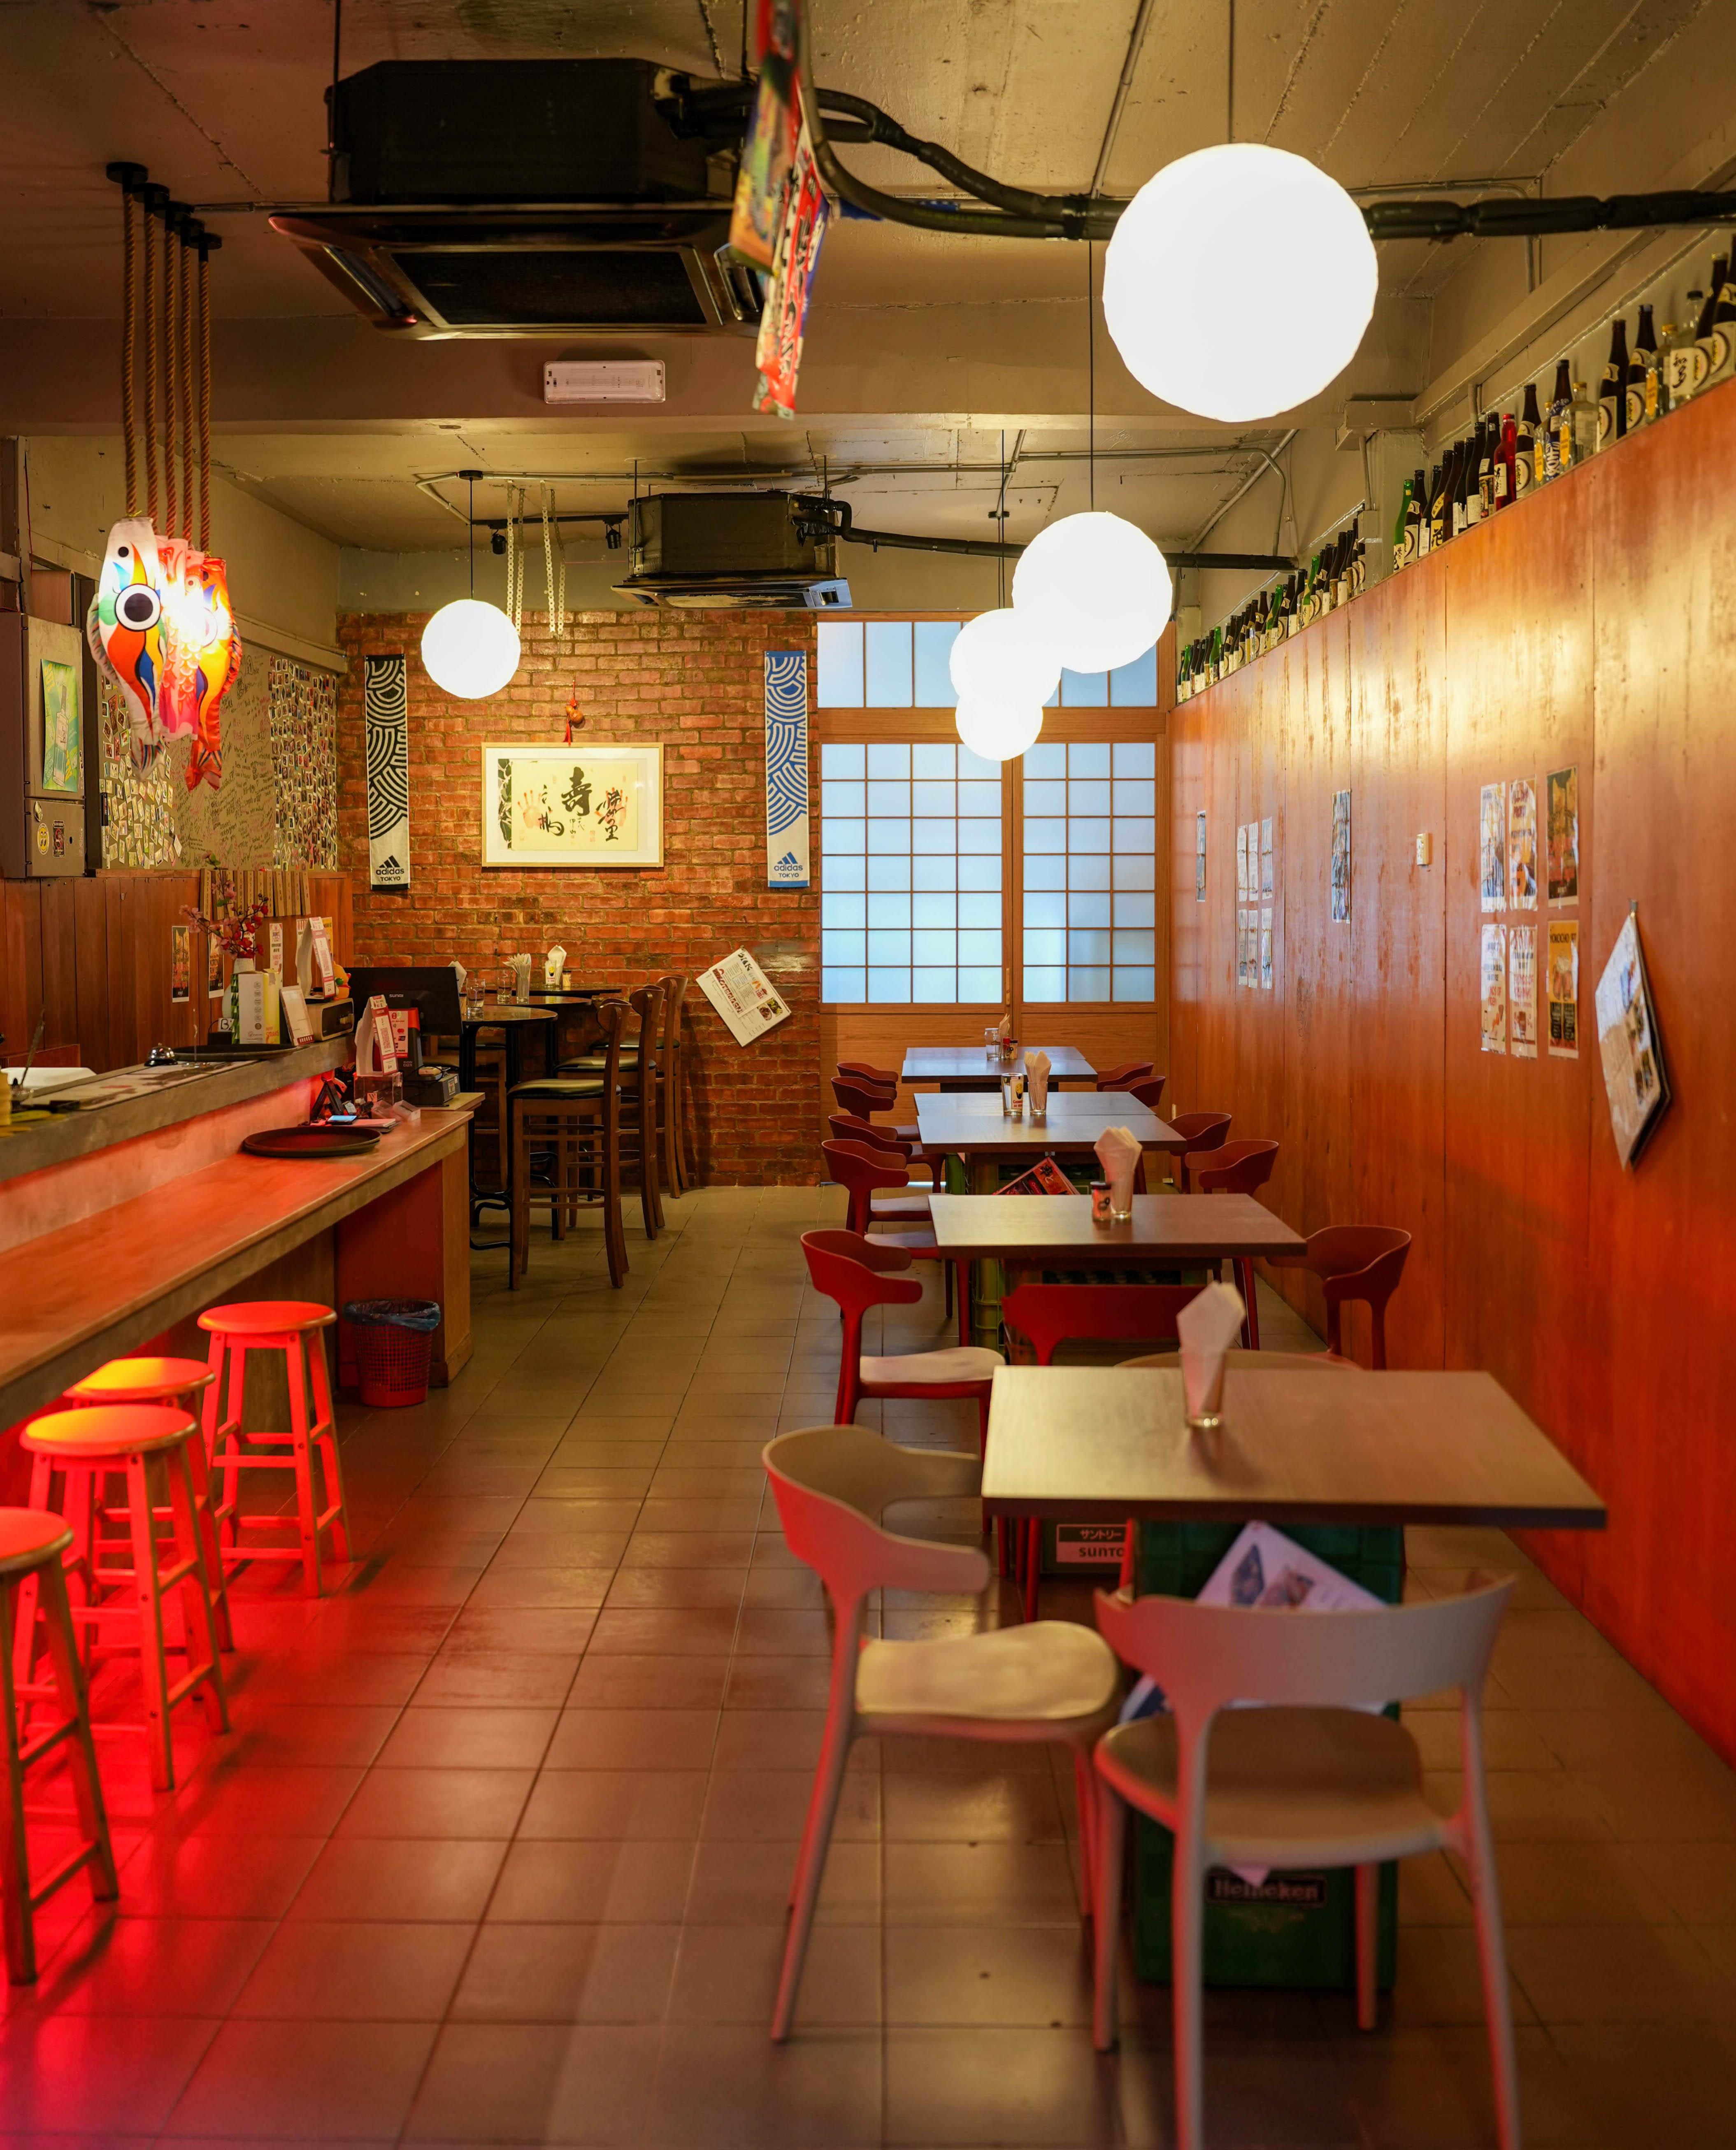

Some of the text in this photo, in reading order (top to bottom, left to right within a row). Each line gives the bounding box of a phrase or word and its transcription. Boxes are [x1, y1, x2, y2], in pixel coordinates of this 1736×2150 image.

[1079, 1529, 1122, 1540] サントリー
[1214, 1879, 1318, 1901] Heineken
